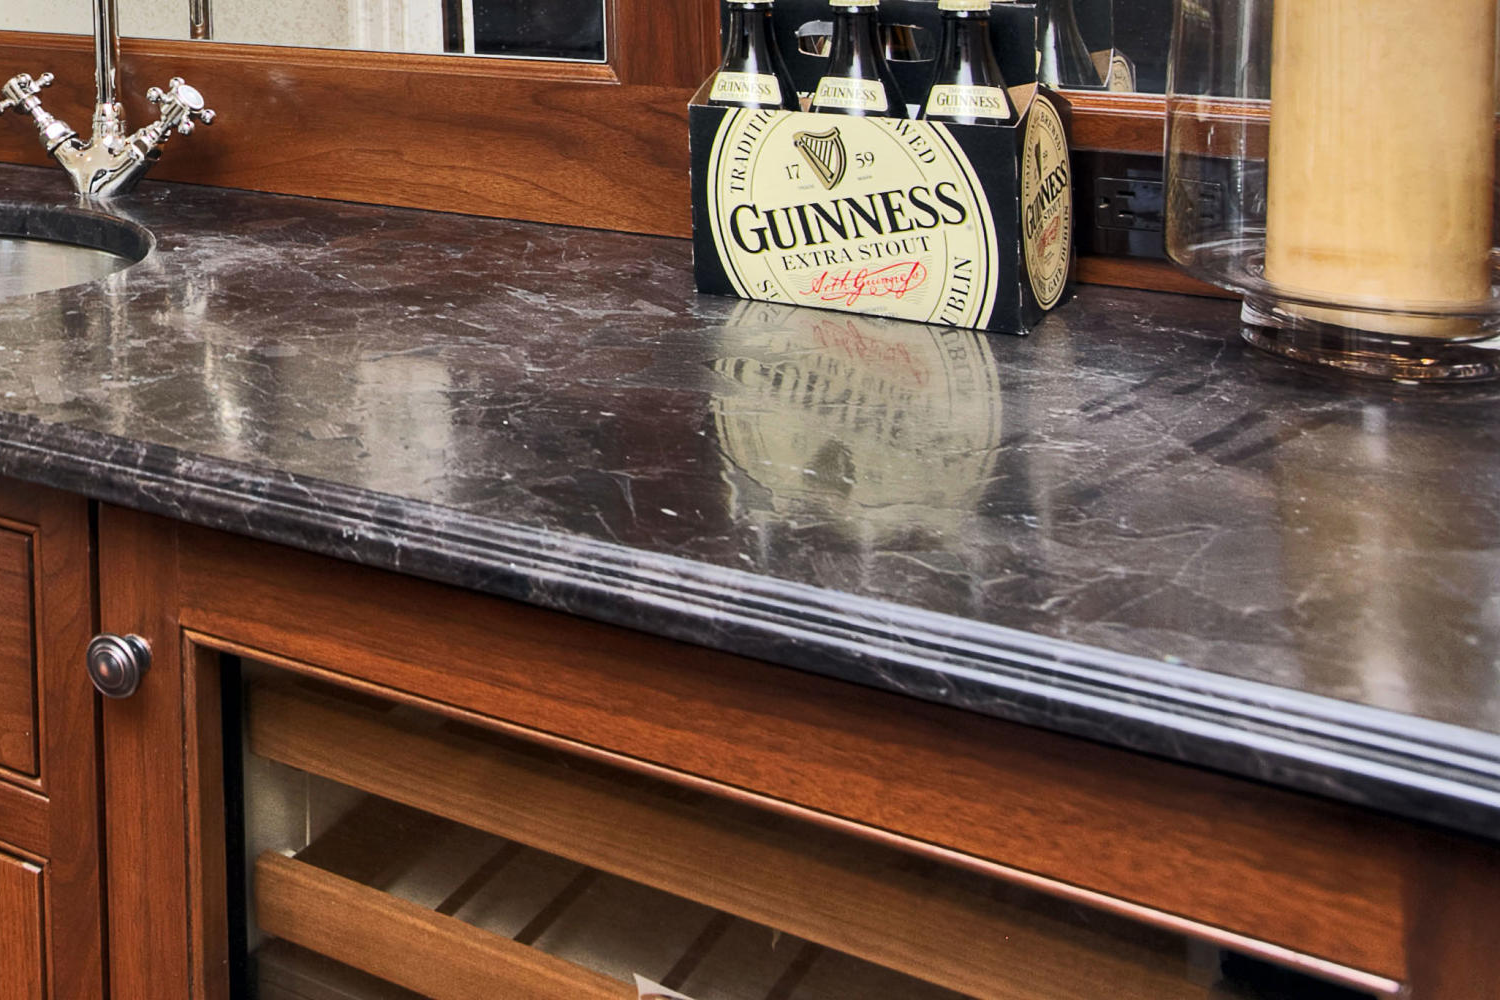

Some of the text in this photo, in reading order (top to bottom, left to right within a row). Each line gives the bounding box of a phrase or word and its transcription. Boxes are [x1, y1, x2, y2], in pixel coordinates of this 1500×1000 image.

[717, 79, 771, 95] GUINNESS
[819, 84, 877, 101] GUINNESS
[936, 92, 1000, 109] GUINNESS
[730, 110, 777, 193] TRADITIO
[785, 151, 875, 180] 17 59
[1025, 159, 1068, 240] GUINNESS
[729, 181, 967, 255] GUINNESS
[781, 236, 930, 271] EXTRA STOUT
[940, 256, 973, 326] UBLIN
